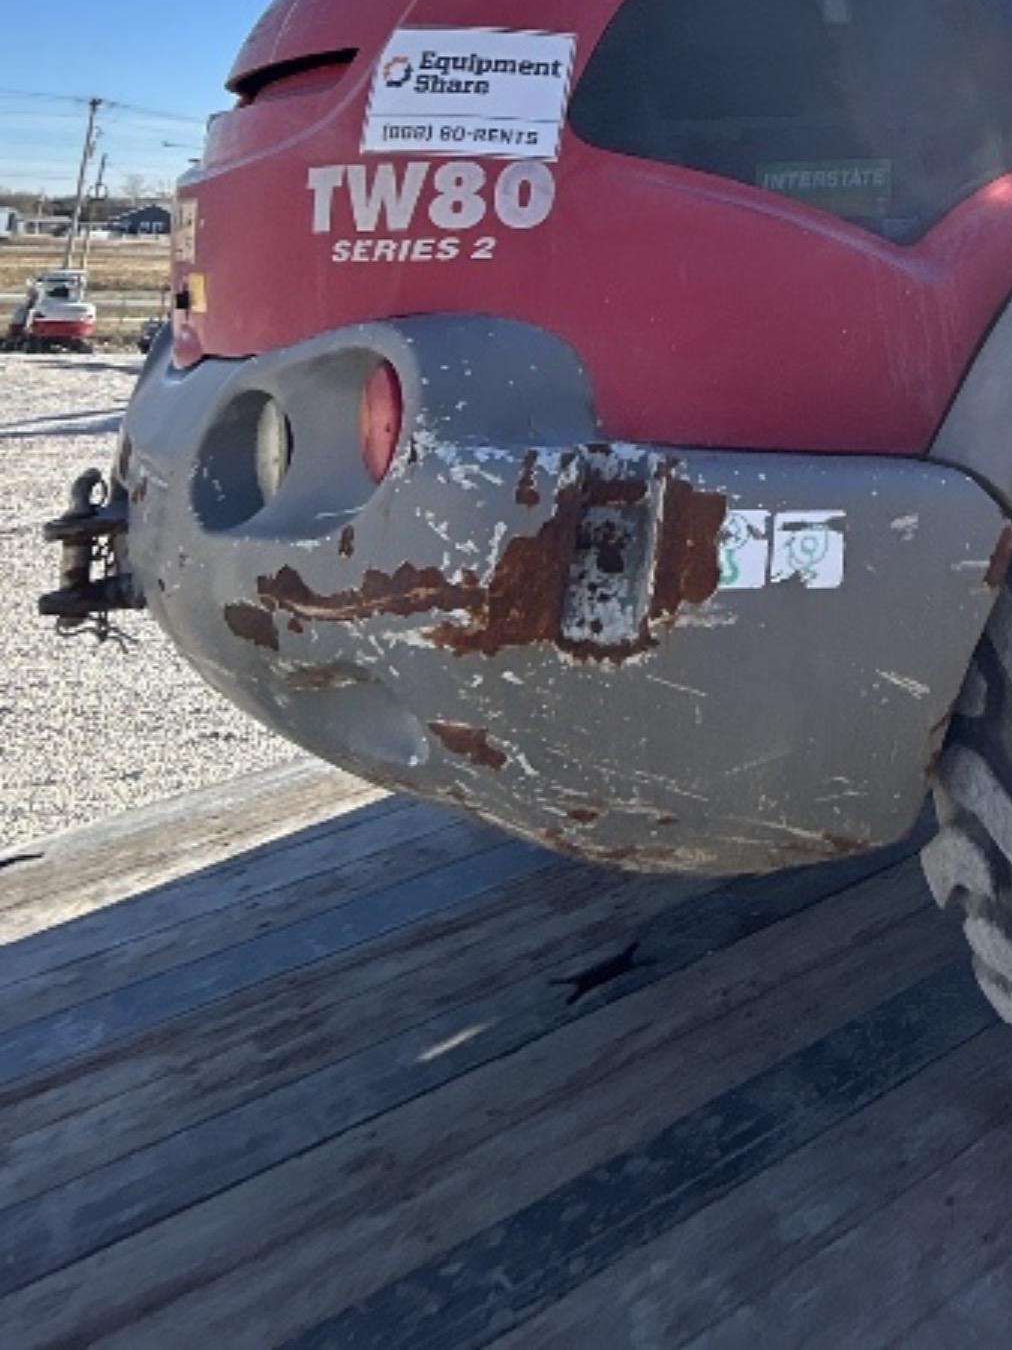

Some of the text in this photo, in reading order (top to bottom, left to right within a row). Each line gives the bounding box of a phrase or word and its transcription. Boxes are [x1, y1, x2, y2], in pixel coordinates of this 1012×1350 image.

[419, 50, 563, 79] Equipment
[413, 74, 490, 95] Share
[763, 166, 884, 191] INTERSTATE
[306, 160, 556, 234] TW80
[331, 236, 497, 262] SERIES 2
